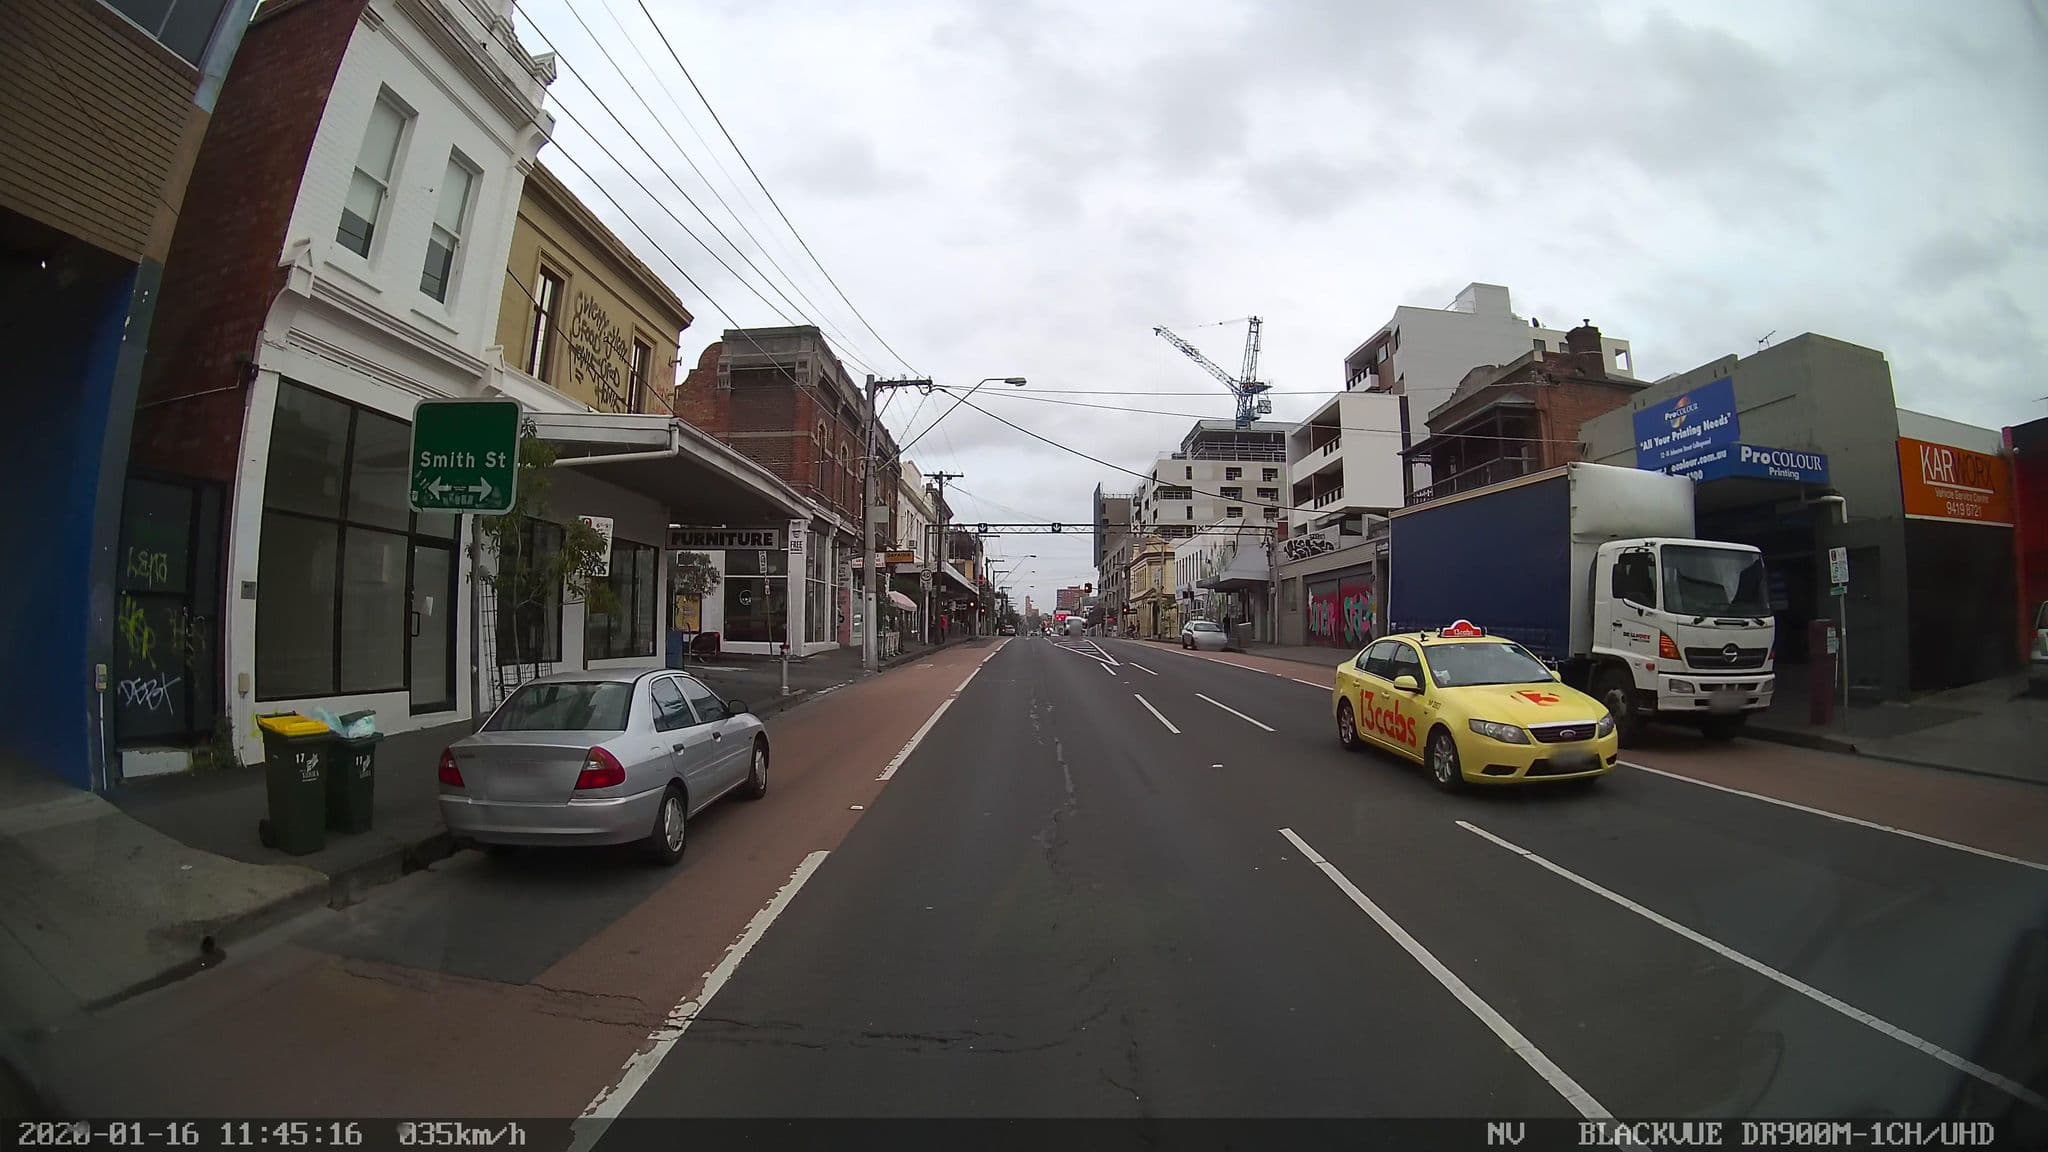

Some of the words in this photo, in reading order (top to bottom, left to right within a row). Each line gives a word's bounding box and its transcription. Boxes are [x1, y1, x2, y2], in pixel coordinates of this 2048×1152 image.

[1654, 435, 1671, 447] Your
[1671, 425, 1702, 441] Printing
[420, 450, 476, 468] Smith
[484, 450, 507, 468] St
[1669, 449, 1727, 472] ocolour.com.au
[1740, 445, 1822, 471] ProCOLOUR
[1768, 466, 1800, 480] Printing
[1946, 501, 1966, 516] 9419
[670, 531, 774, 547] FURNITURE
[1359, 689, 1417, 749] 13cabs
